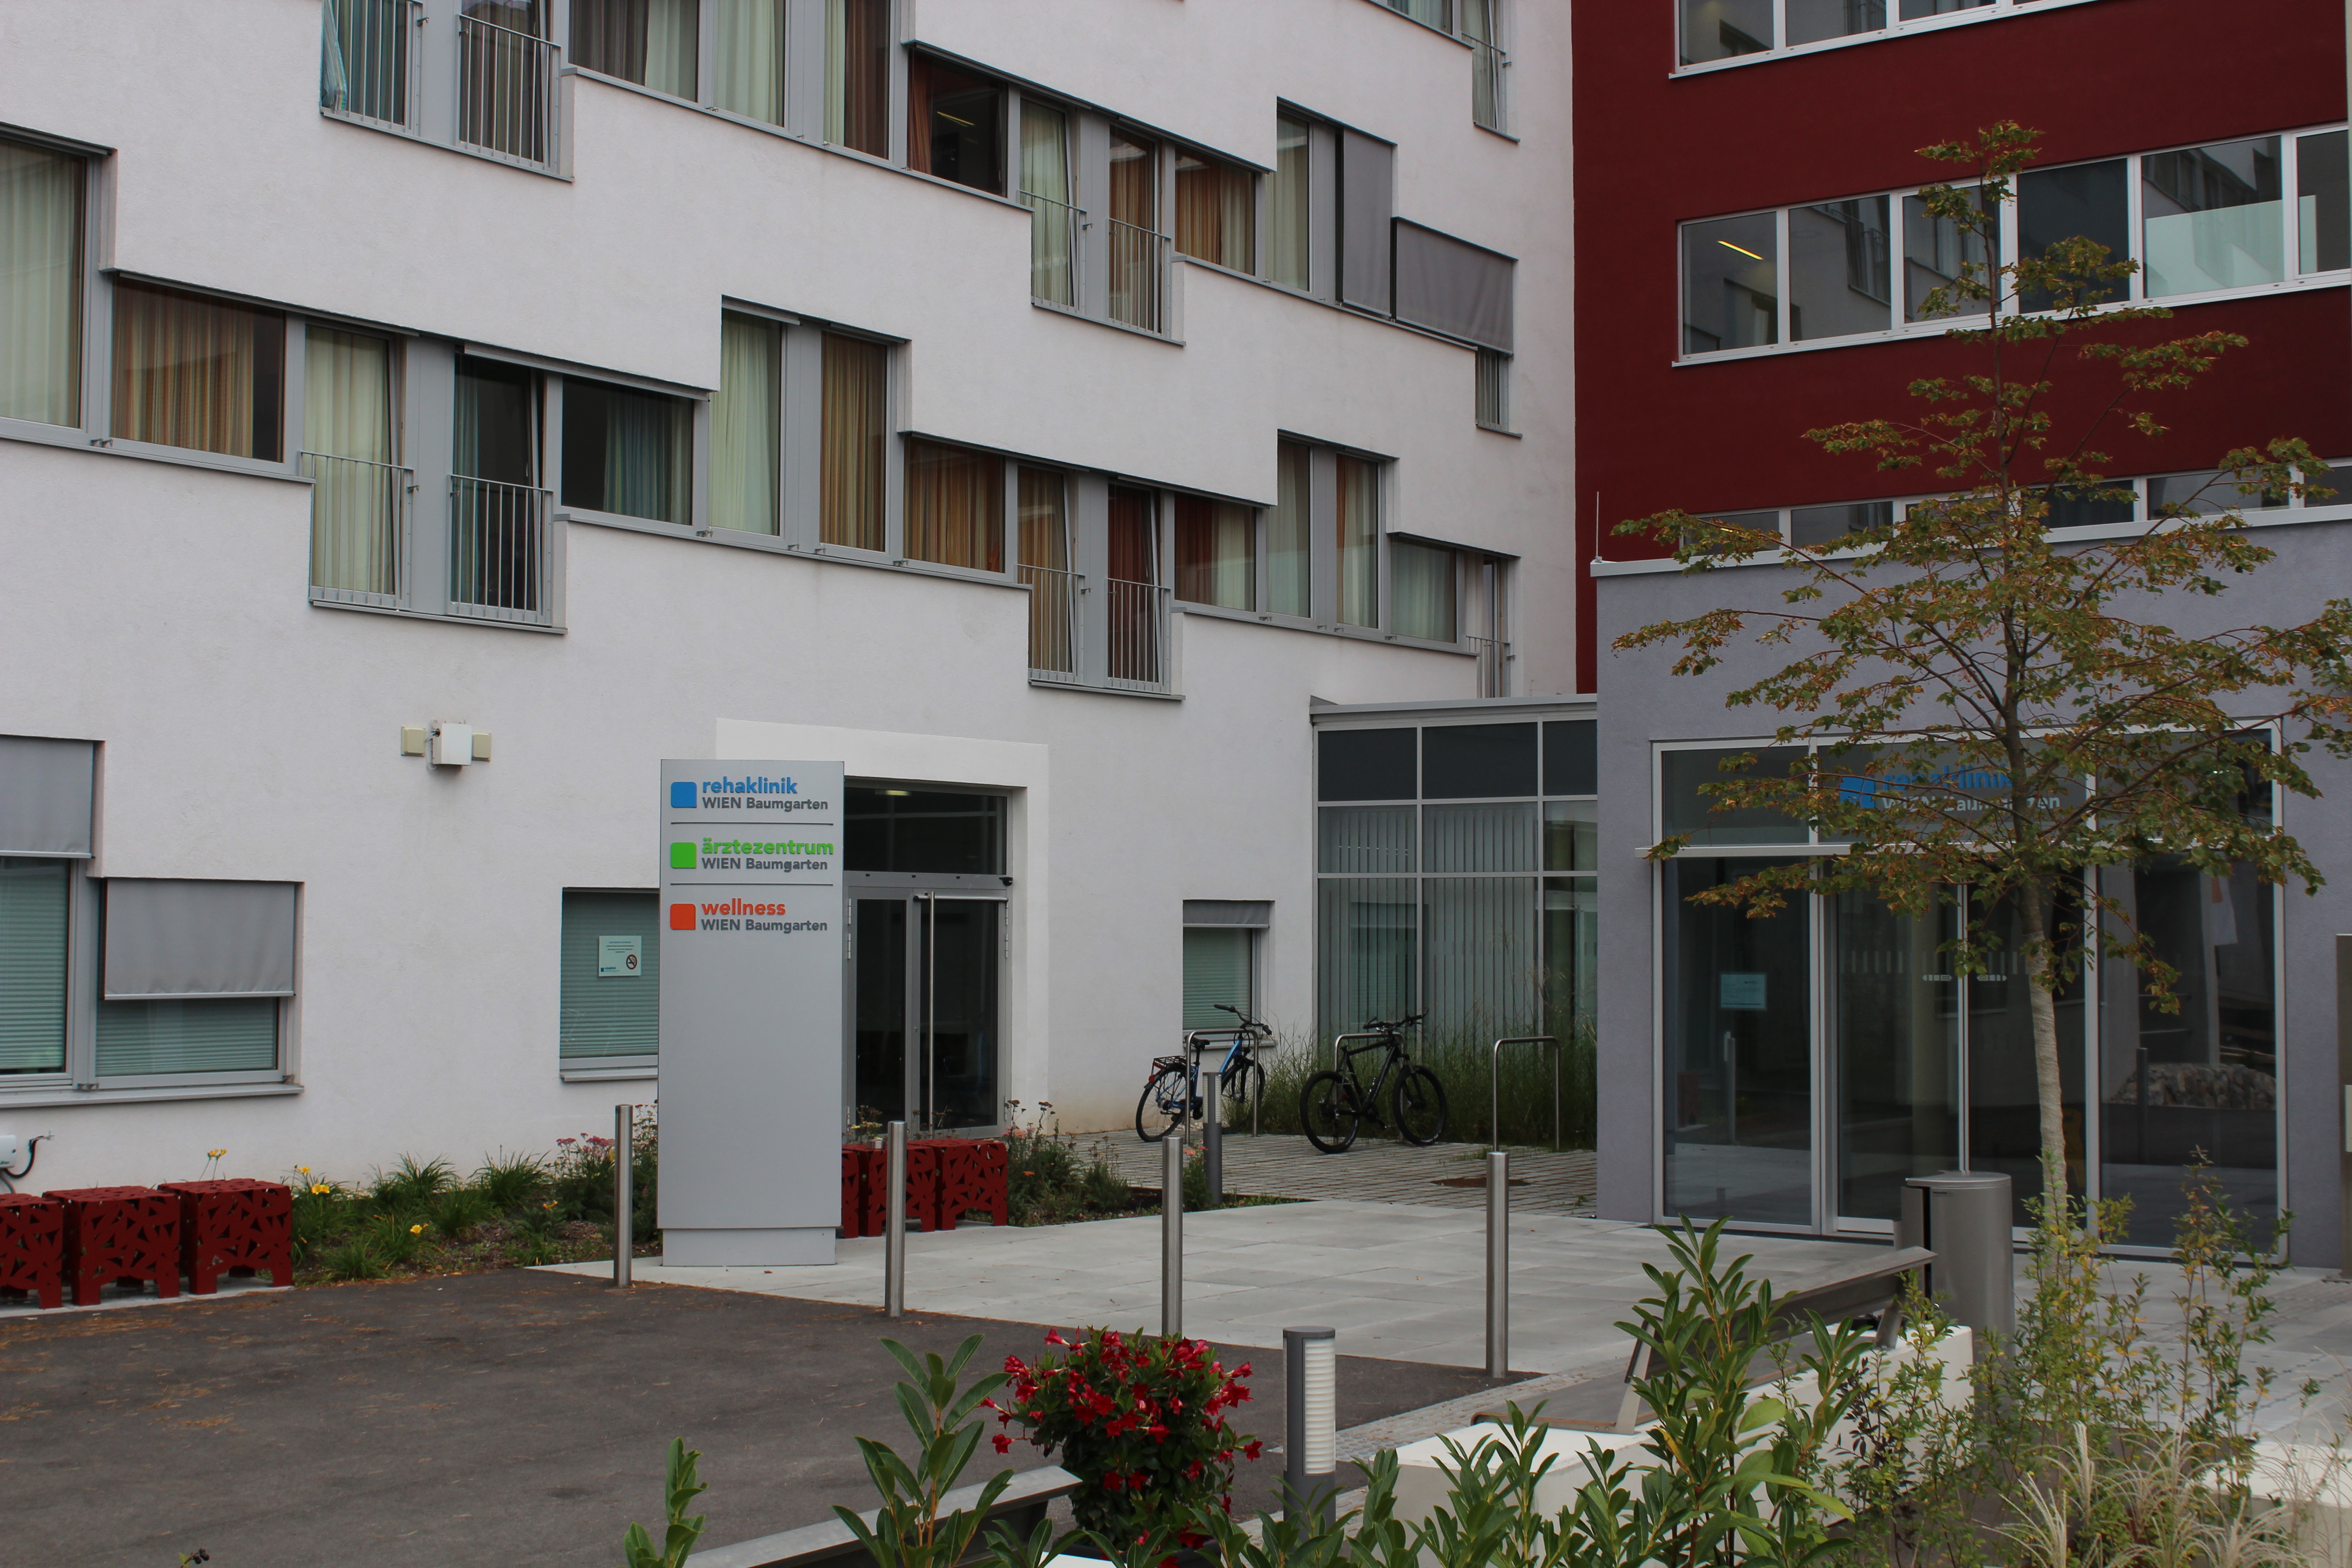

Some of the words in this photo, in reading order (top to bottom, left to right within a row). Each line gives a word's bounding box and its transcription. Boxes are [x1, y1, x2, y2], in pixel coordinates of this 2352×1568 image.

[702, 776, 798, 794] rehaklinik
[702, 797, 741, 808] WIEN
[746, 797, 828, 812] Baumgarten
[702, 838, 834, 854] ärztezentrum
[701, 858, 741, 869] WIEN
[746, 858, 828, 872] Baumgarten
[701, 898, 786, 915] wellness
[701, 919, 740, 931] WIEN
[745, 919, 828, 934] Baumgarten
